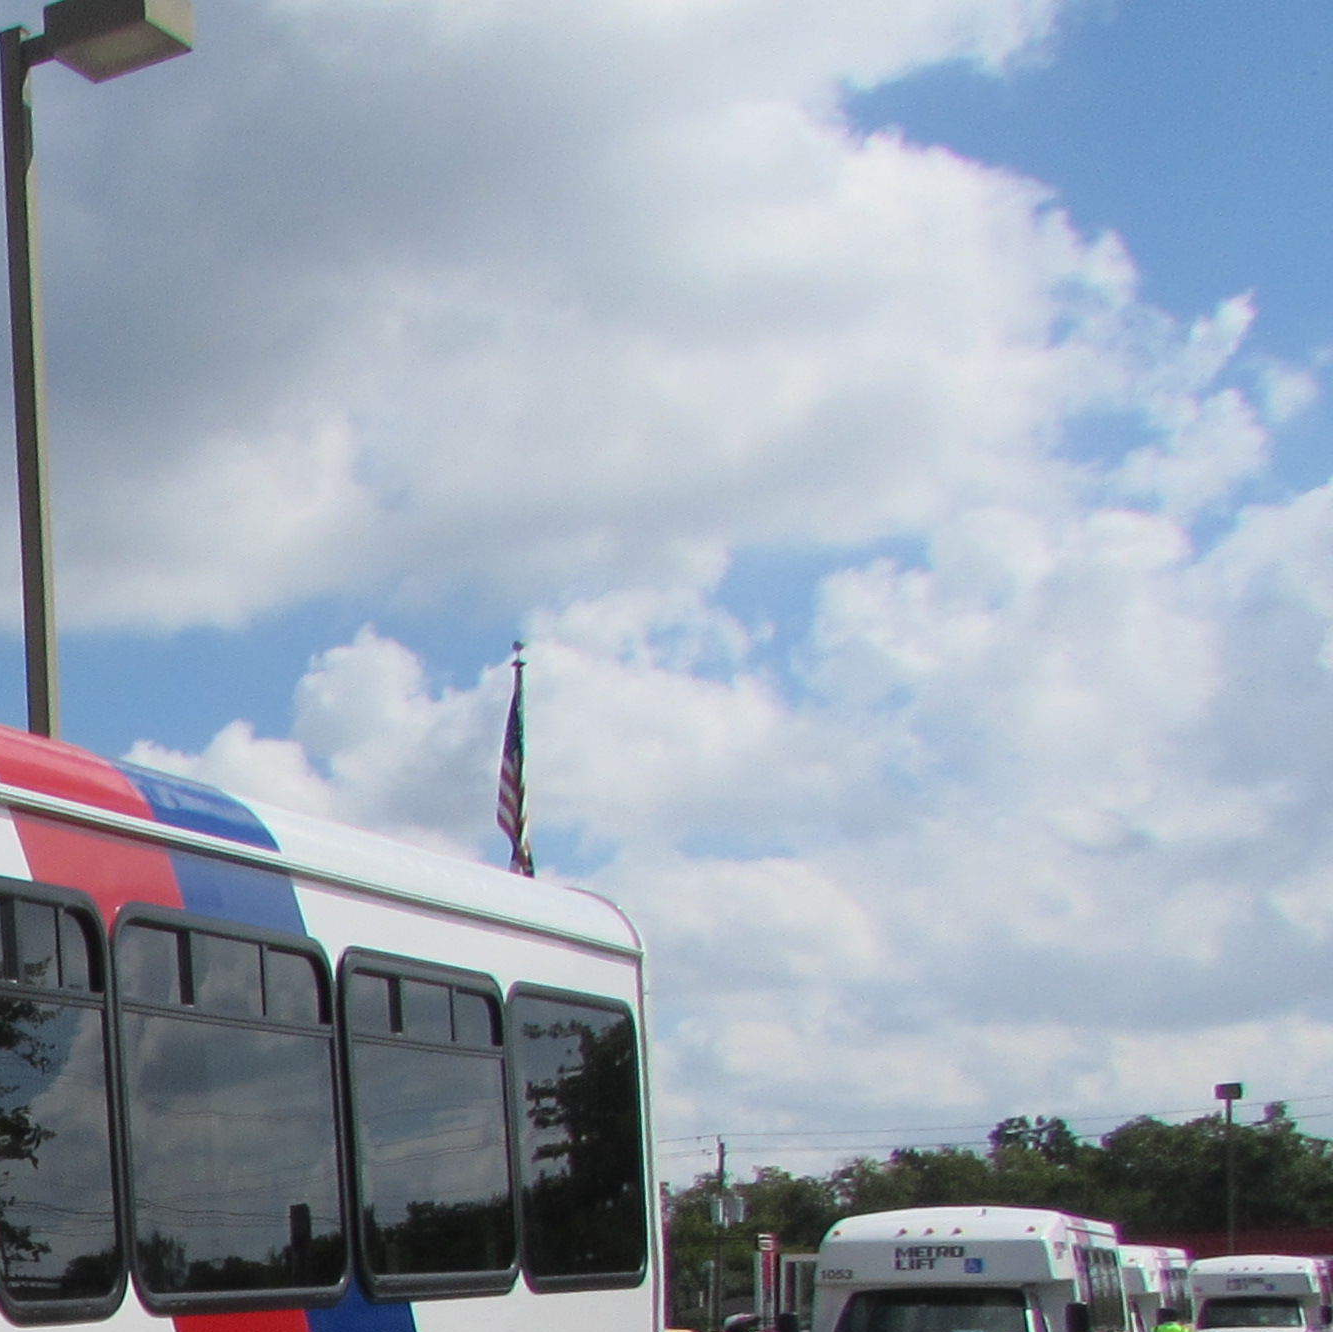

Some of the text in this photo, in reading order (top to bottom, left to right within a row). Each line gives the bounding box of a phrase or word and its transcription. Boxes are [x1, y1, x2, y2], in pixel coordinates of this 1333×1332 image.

[894, 1246, 965, 1258] METRO
[894, 1258, 938, 1271] LIFT
[820, 1269, 854, 1280] 1053
